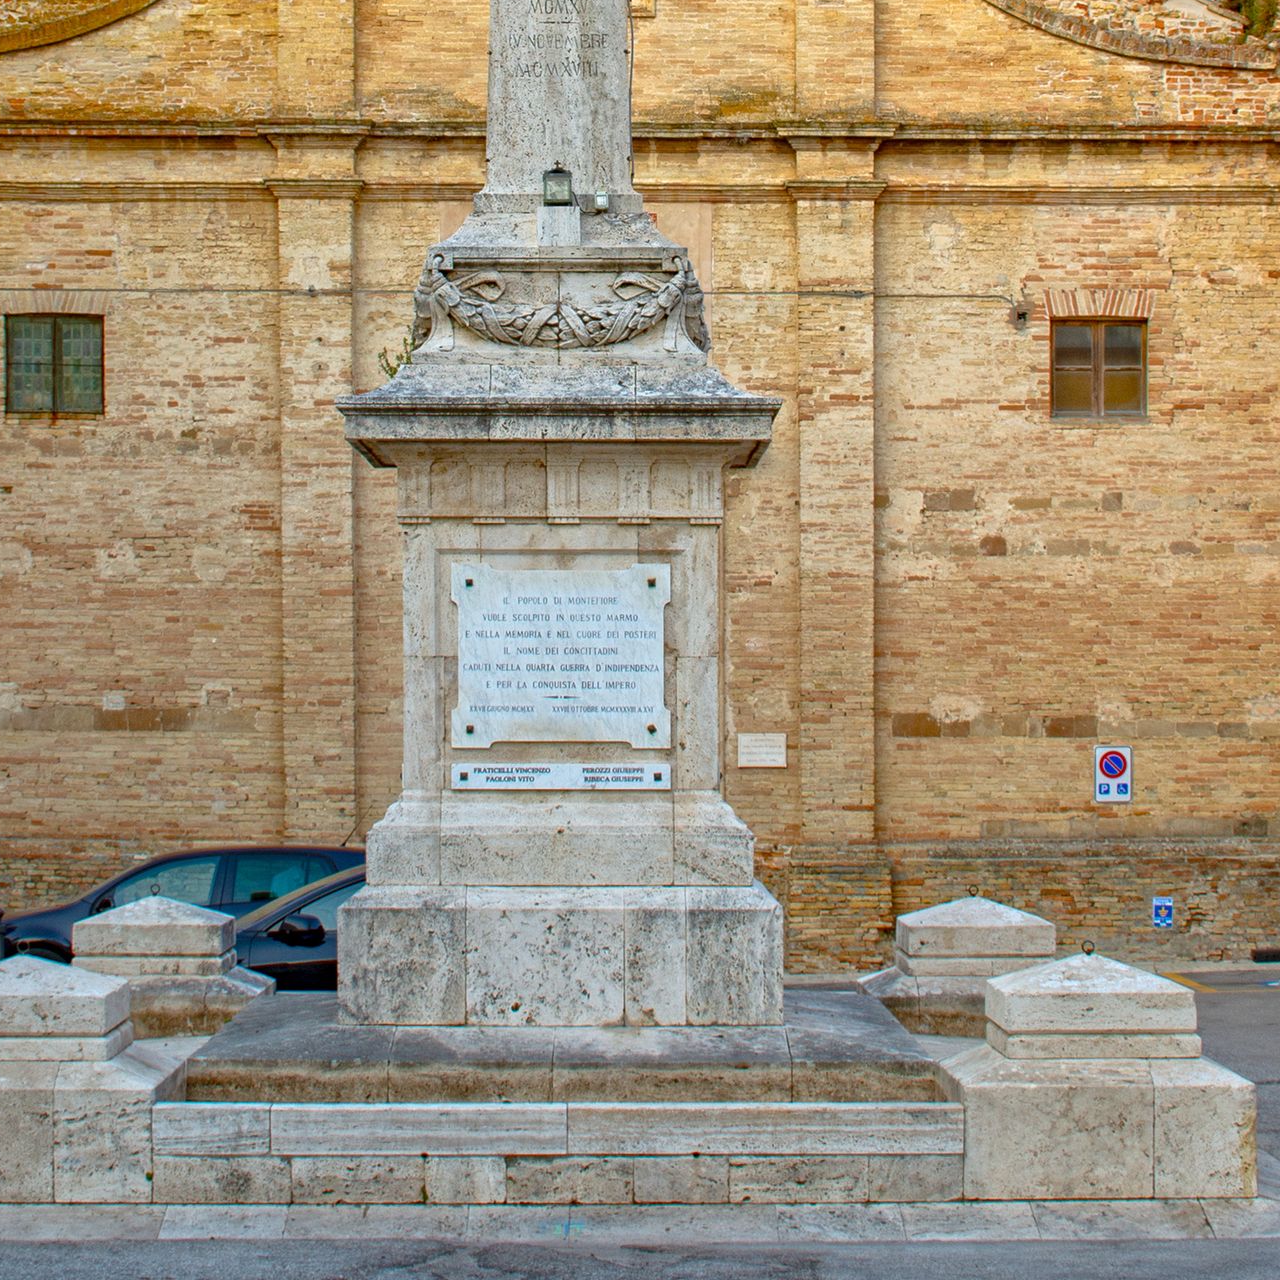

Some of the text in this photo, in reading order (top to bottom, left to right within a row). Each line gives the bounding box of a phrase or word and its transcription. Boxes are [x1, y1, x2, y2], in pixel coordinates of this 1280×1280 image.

[528, 0, 588, 14] MCMXV
[528, 34, 609, 49] NOVEMBRE
[503, 597, 618, 605] IL POPOLO DI MONTEFIORE
[482, 614, 639, 622] VUOLE SCOLPITO IN QUESTO MARMO
[465, 631, 657, 639] E NELLA MEMORIA E NEL CUORE DEI POSTERI
[503, 647, 619, 655] IL NOME DEI CONCITTADINI
[463, 664, 491, 672] CADUTI
[496, 664, 521, 672] NELLA
[526, 664, 555, 672] QUARTA
[560, 664, 590, 672] GUERRA
[486, 681, 492, 689] E
[496, 681, 512, 689] PER
[517, 681, 527, 689] LA
[532, 681, 576, 689] CONQUISTA
